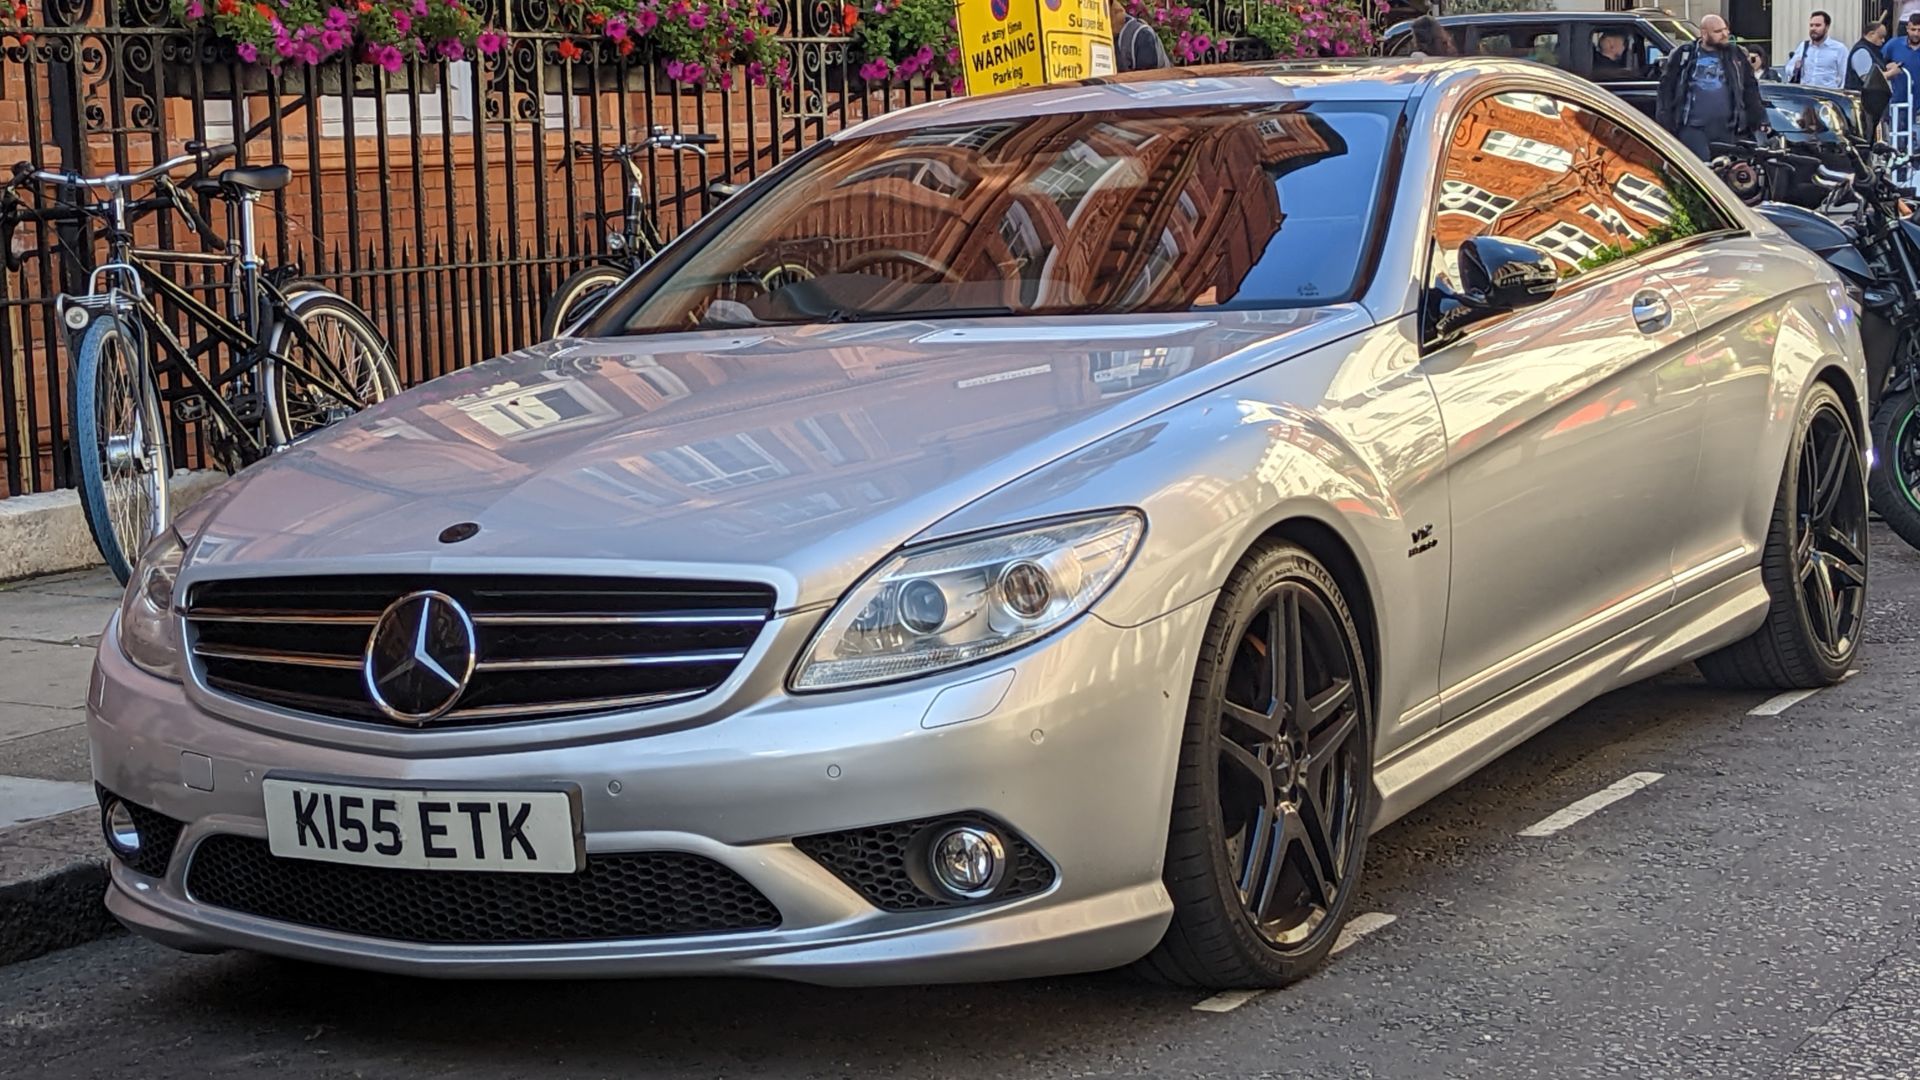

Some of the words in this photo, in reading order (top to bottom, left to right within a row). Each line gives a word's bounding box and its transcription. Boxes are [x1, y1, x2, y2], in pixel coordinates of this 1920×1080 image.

[982, 31, 991, 43] at
[992, 28, 1005, 40] any
[1007, 21, 1022, 34] time
[971, 32, 1035, 72] WARNING
[993, 67, 1023, 86] Parking
[417, 801, 538, 860] ETK
